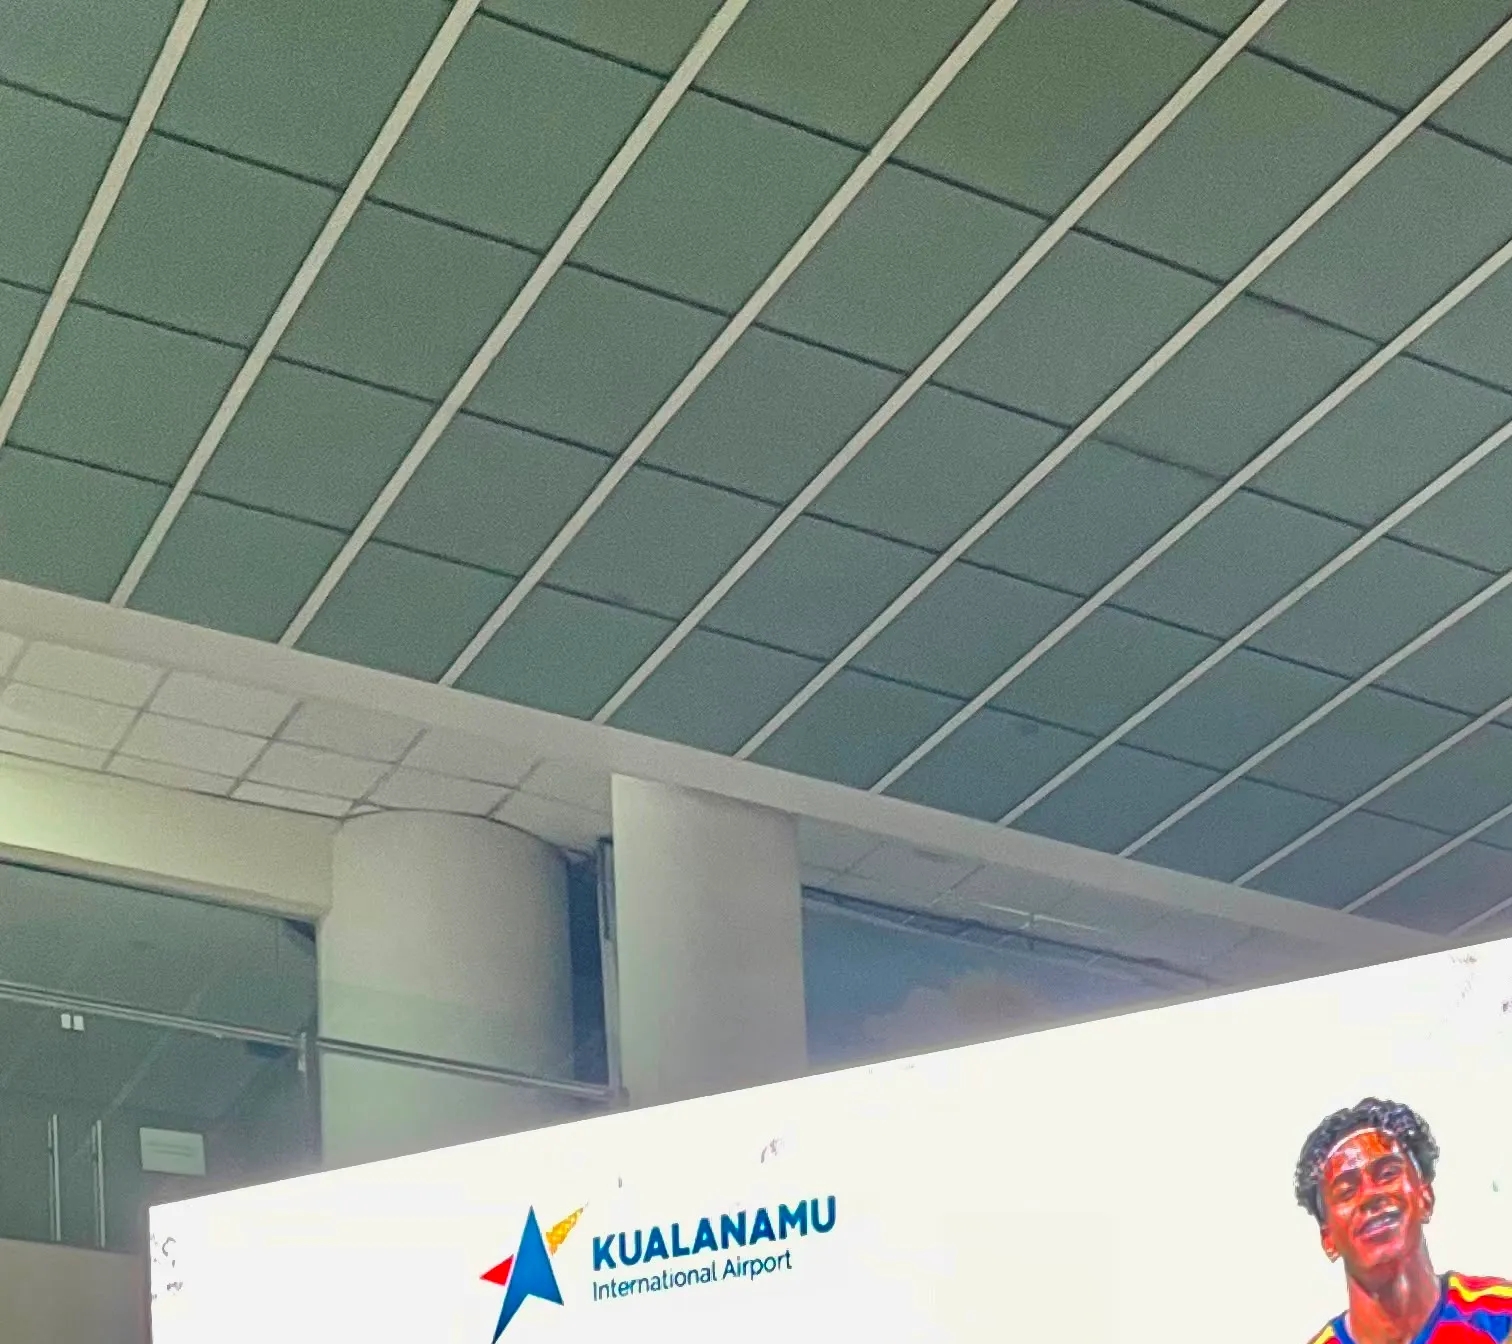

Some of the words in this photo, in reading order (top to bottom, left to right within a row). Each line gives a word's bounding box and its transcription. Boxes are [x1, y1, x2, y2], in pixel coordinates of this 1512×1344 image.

[592, 1195, 837, 1271] KUALANAMU
[592, 1260, 717, 1302] International
[722, 1250, 793, 1282] Airport
